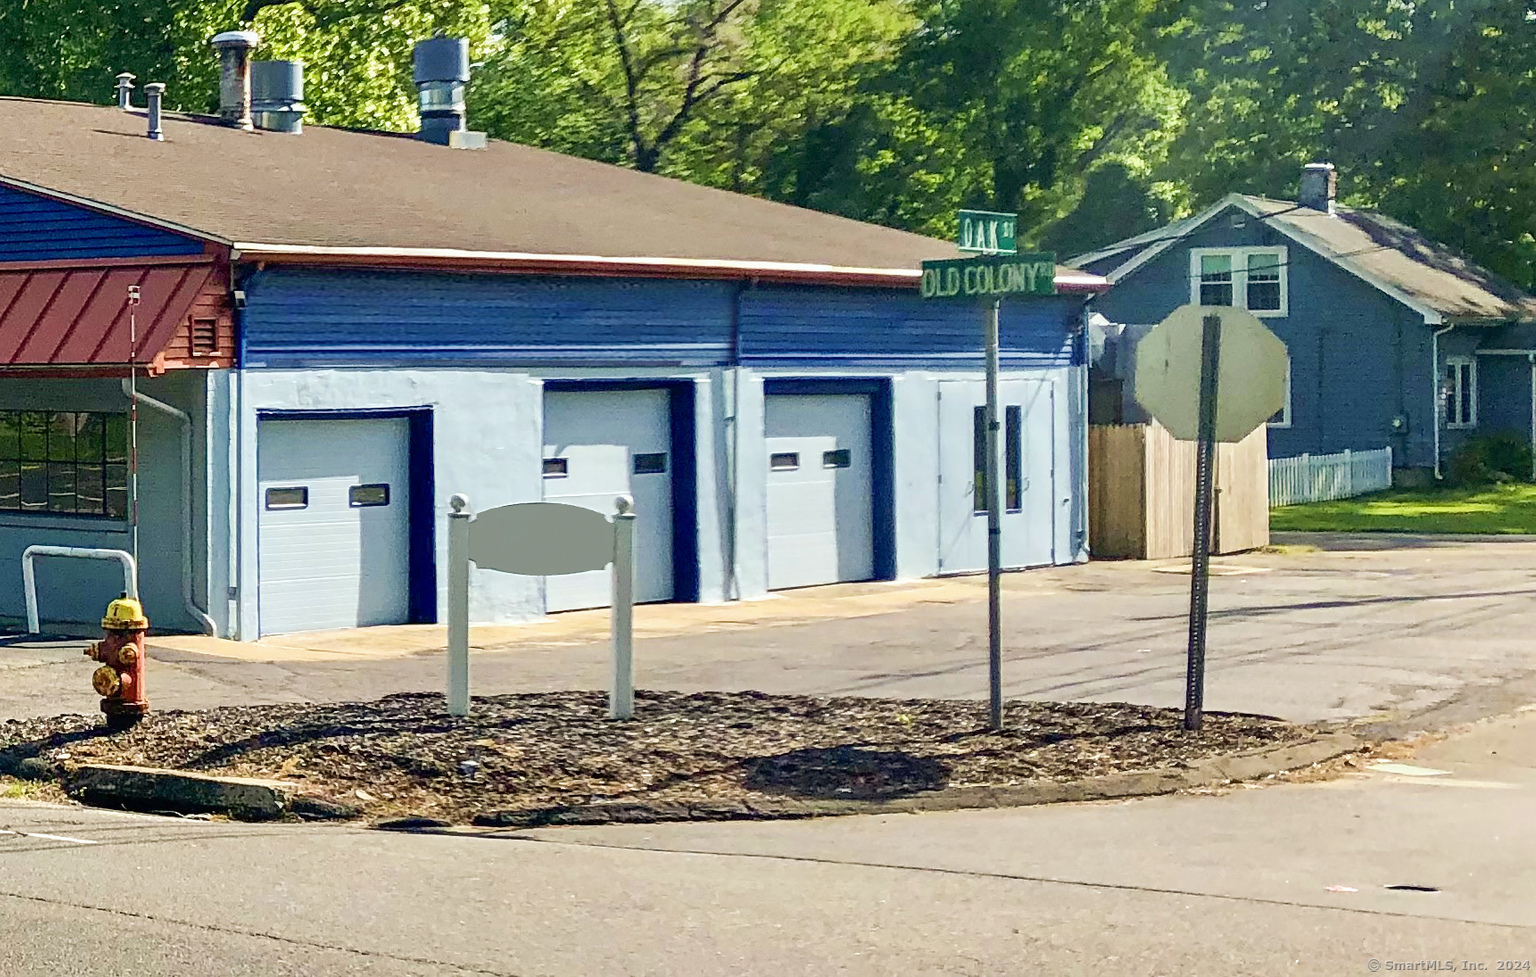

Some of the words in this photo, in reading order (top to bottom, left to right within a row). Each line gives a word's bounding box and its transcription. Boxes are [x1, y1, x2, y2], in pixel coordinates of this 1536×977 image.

[964, 218, 998, 249] OAK
[922, 268, 959, 297] OLD
[965, 263, 1038, 294] COLONY
